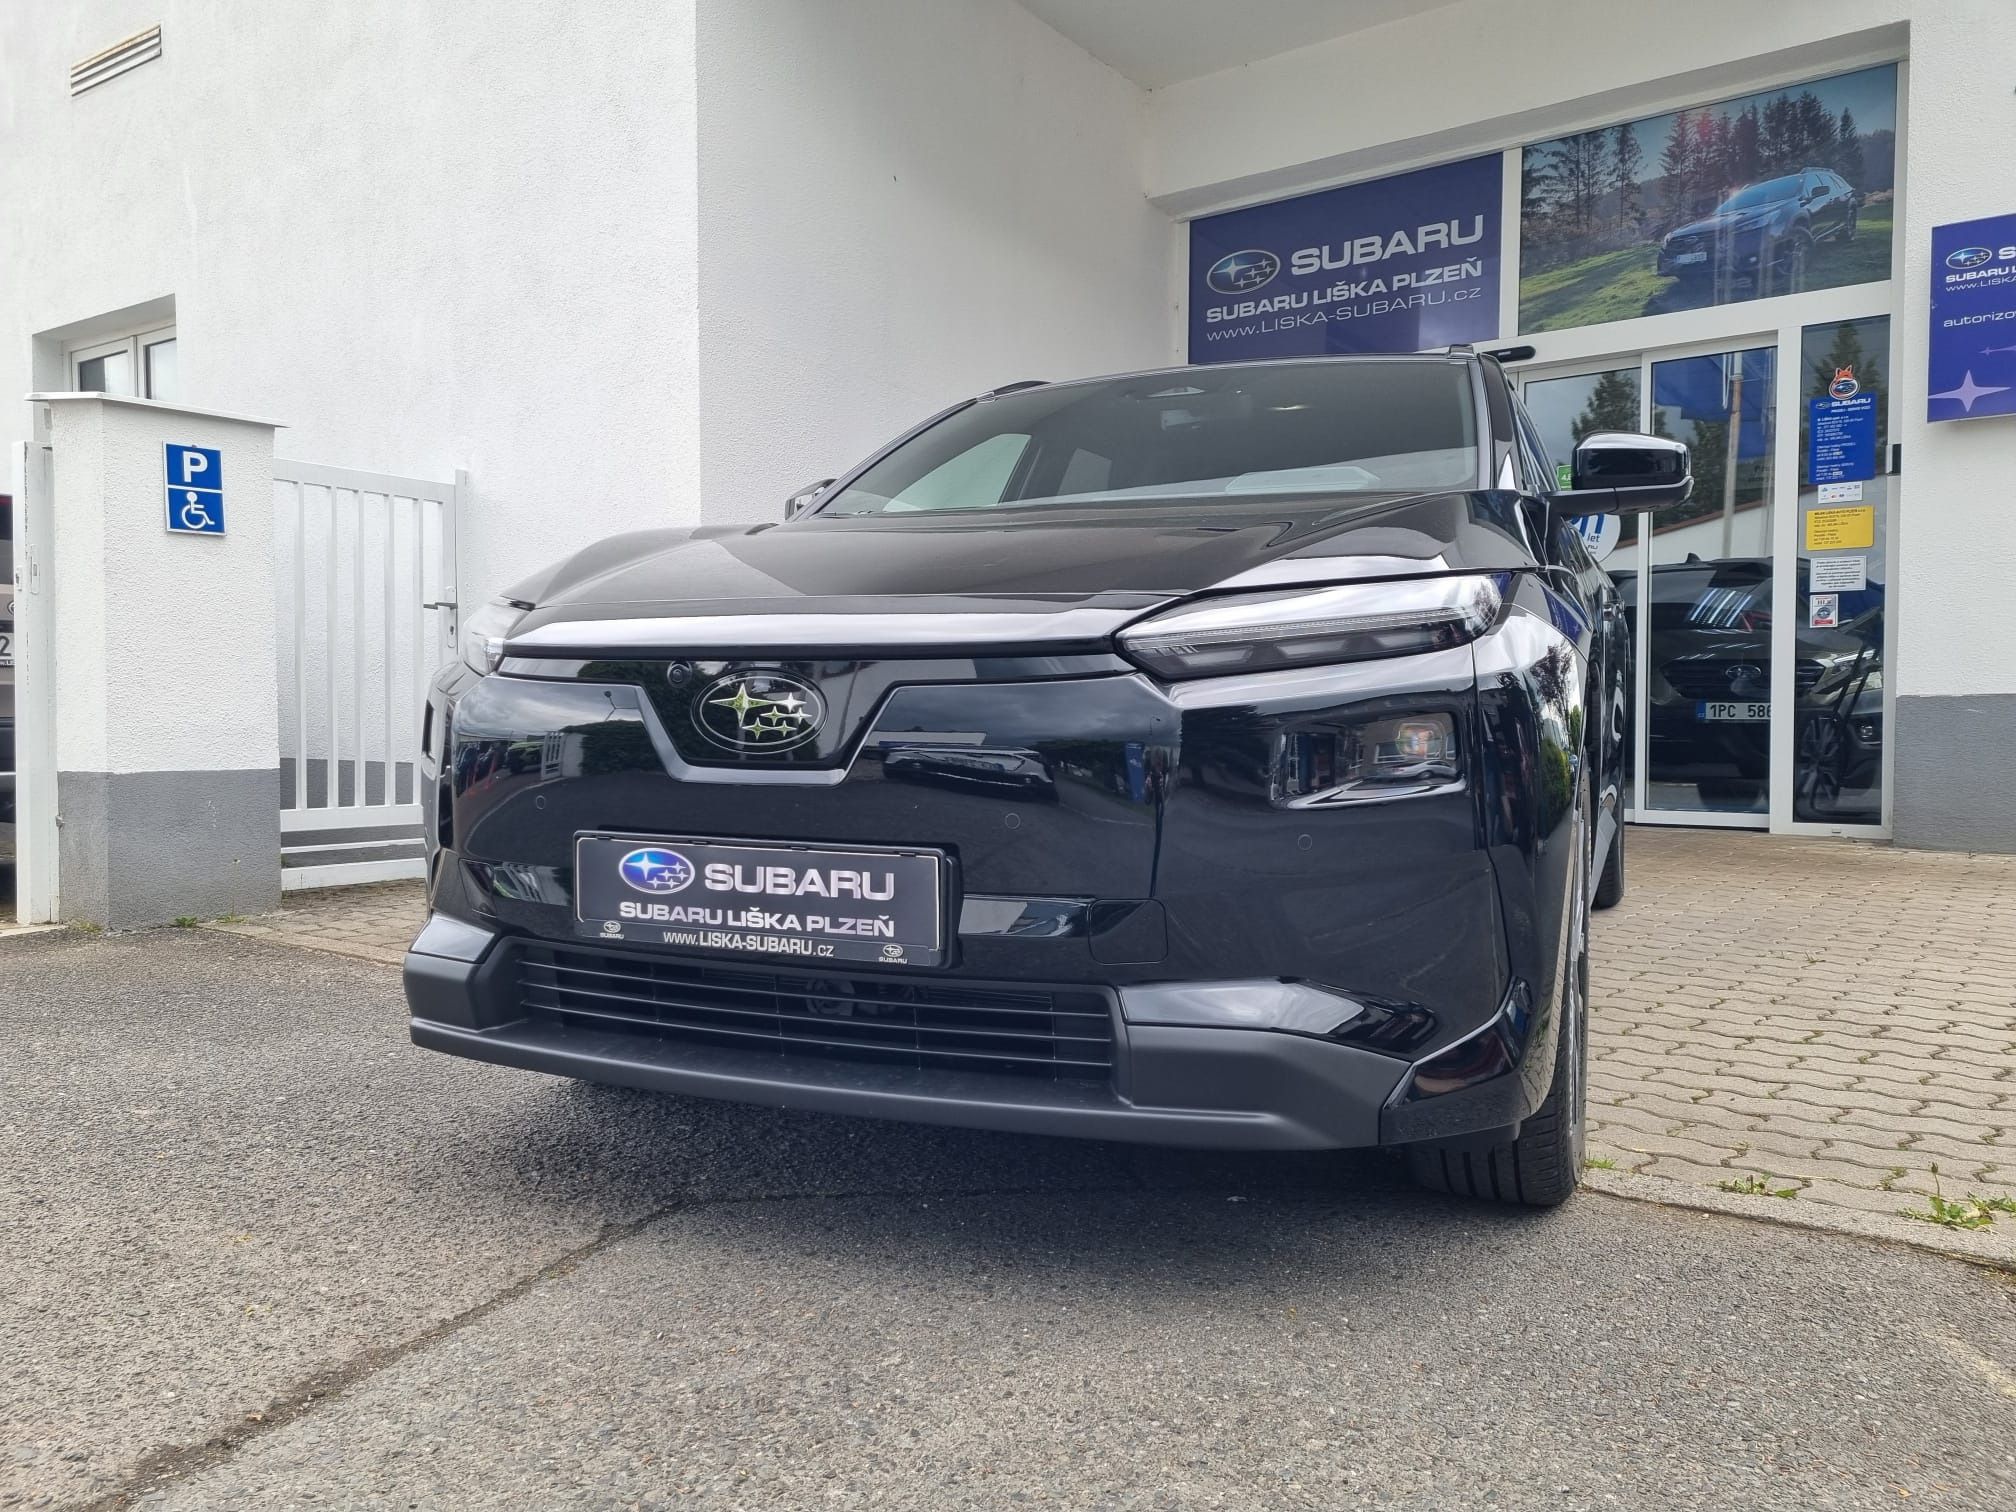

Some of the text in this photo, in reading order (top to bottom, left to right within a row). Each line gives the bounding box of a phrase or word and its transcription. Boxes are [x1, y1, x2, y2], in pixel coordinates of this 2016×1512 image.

[1291, 214, 1484, 276] SUBARU
[1206, 256, 1483, 324] SUBARU LIŠKA PLZEŇ
[1945, 266, 2009, 284] SUBARU
[1207, 286, 1481, 342] www.LISKA-SUBARU.cz
[1831, 398, 1871, 407] SUBARU
[183, 451, 208, 483] P
[1710, 704, 1736, 718] 1PC
[704, 863, 895, 901] SUBARU
[619, 901, 895, 937] SUBARU LIŠKA PLZEŇ
[599, 932, 625, 940] SUBARU
[878, 956, 908, 965] SUBARU
